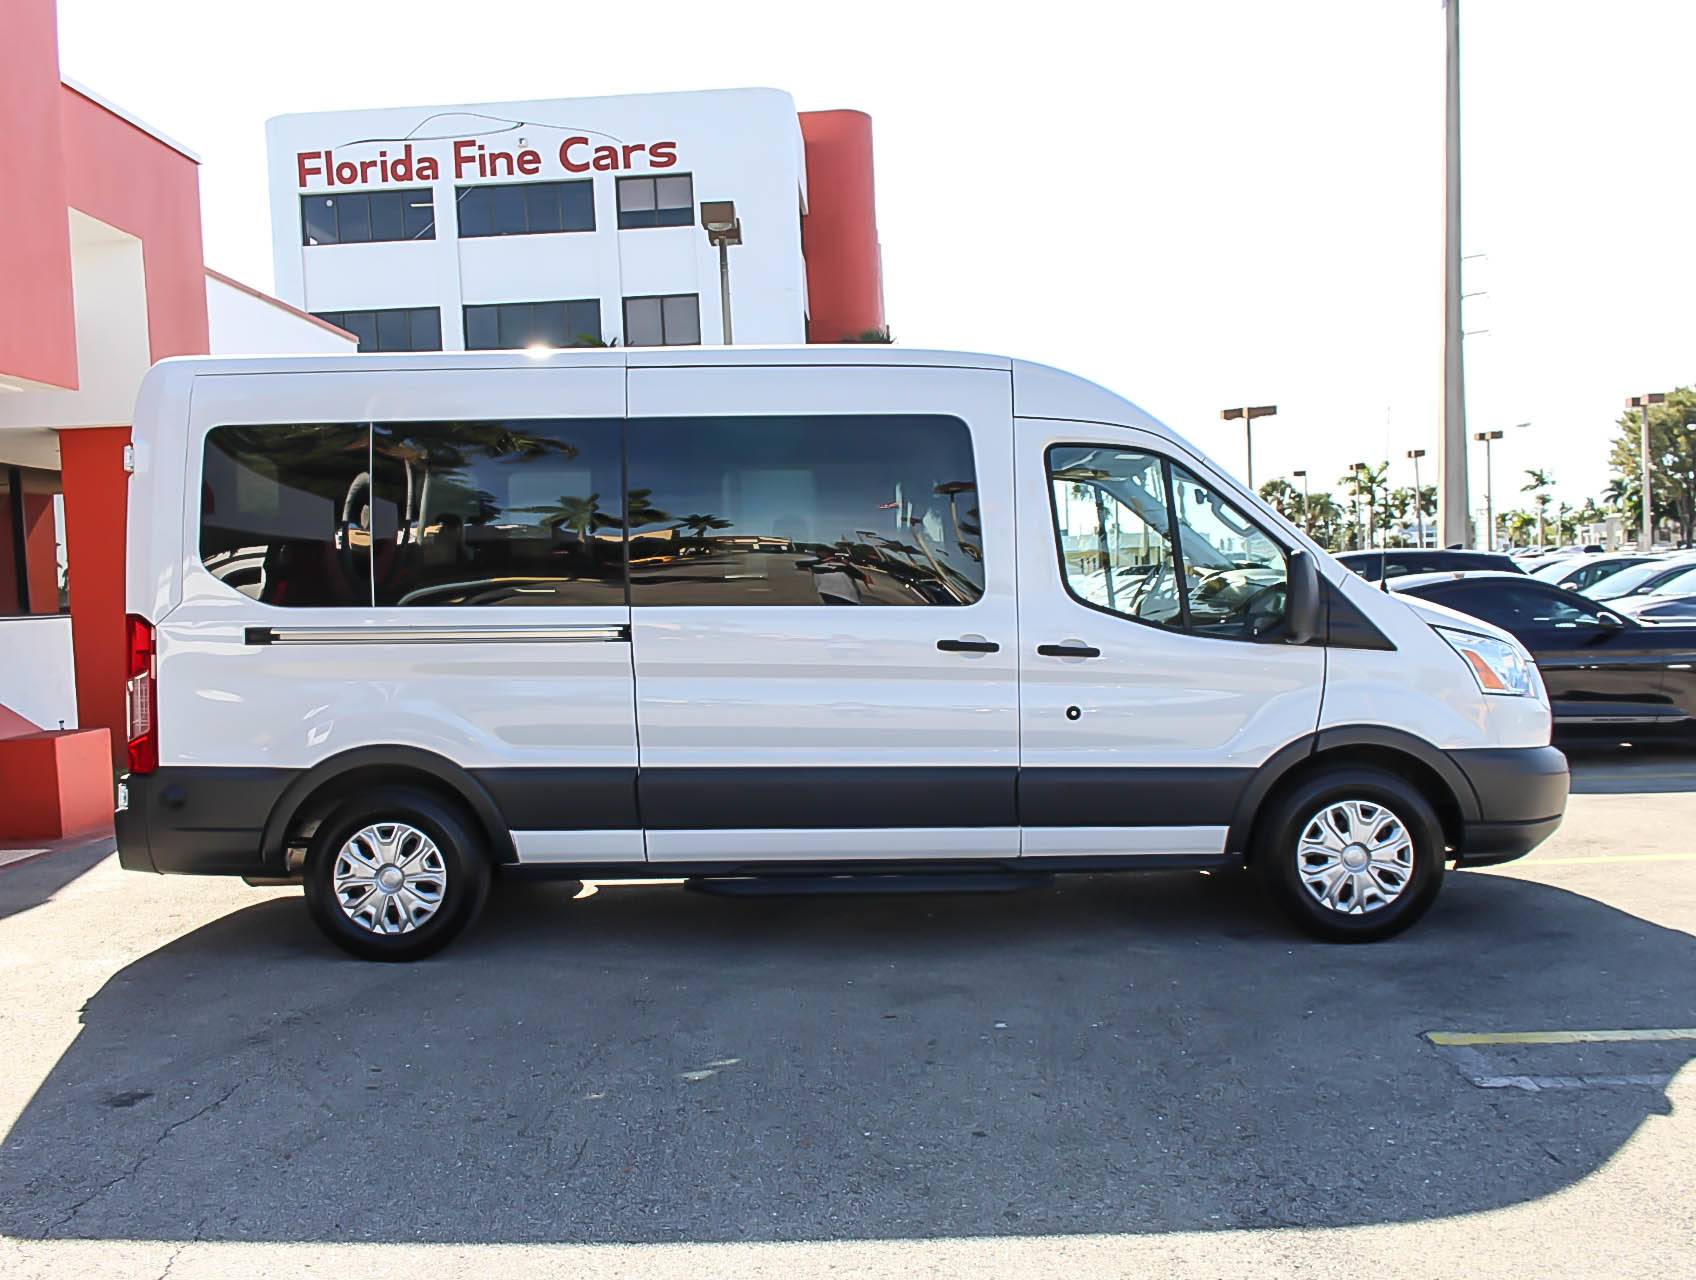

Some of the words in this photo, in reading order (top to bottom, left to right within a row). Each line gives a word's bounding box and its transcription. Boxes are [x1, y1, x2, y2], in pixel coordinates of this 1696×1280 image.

[297, 144, 439, 188] Florida
[453, 139, 542, 179] Fine
[559, 136, 677, 173] Cars
